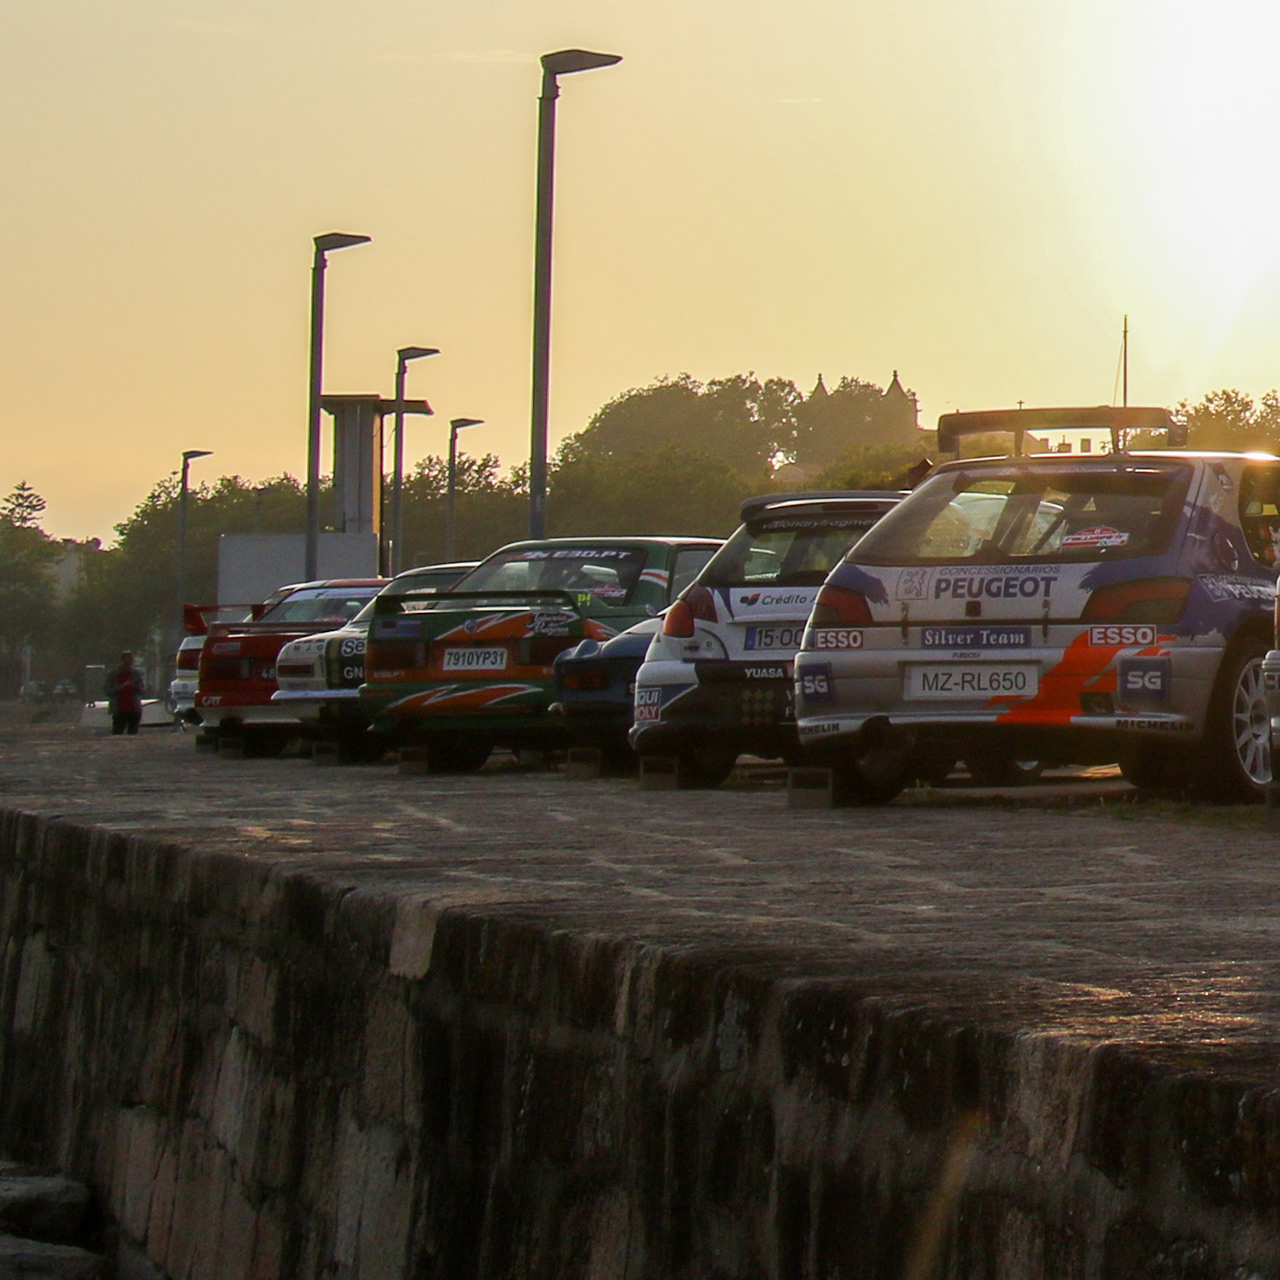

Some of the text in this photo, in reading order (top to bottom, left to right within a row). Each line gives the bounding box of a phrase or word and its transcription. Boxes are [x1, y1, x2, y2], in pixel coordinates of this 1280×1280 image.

[935, 577, 1057, 599] PEUGEOT
[761, 594, 807, 606] Crédito
[817, 631, 862, 648] ESSO
[924, 629, 1026, 645] Silver Team
[1091, 628, 1153, 644] ESSO
[446, 651, 505, 666] 7910YP31
[745, 668, 784, 678] YUASA
[1126, 671, 1162, 690] SG
[803, 675, 829, 694] SG
[922, 672, 1027, 691] MZ-RL650
[638, 691, 659, 704] QUI
[636, 706, 658, 719] OLY
[1116, 719, 1195, 731] MICHELIN
